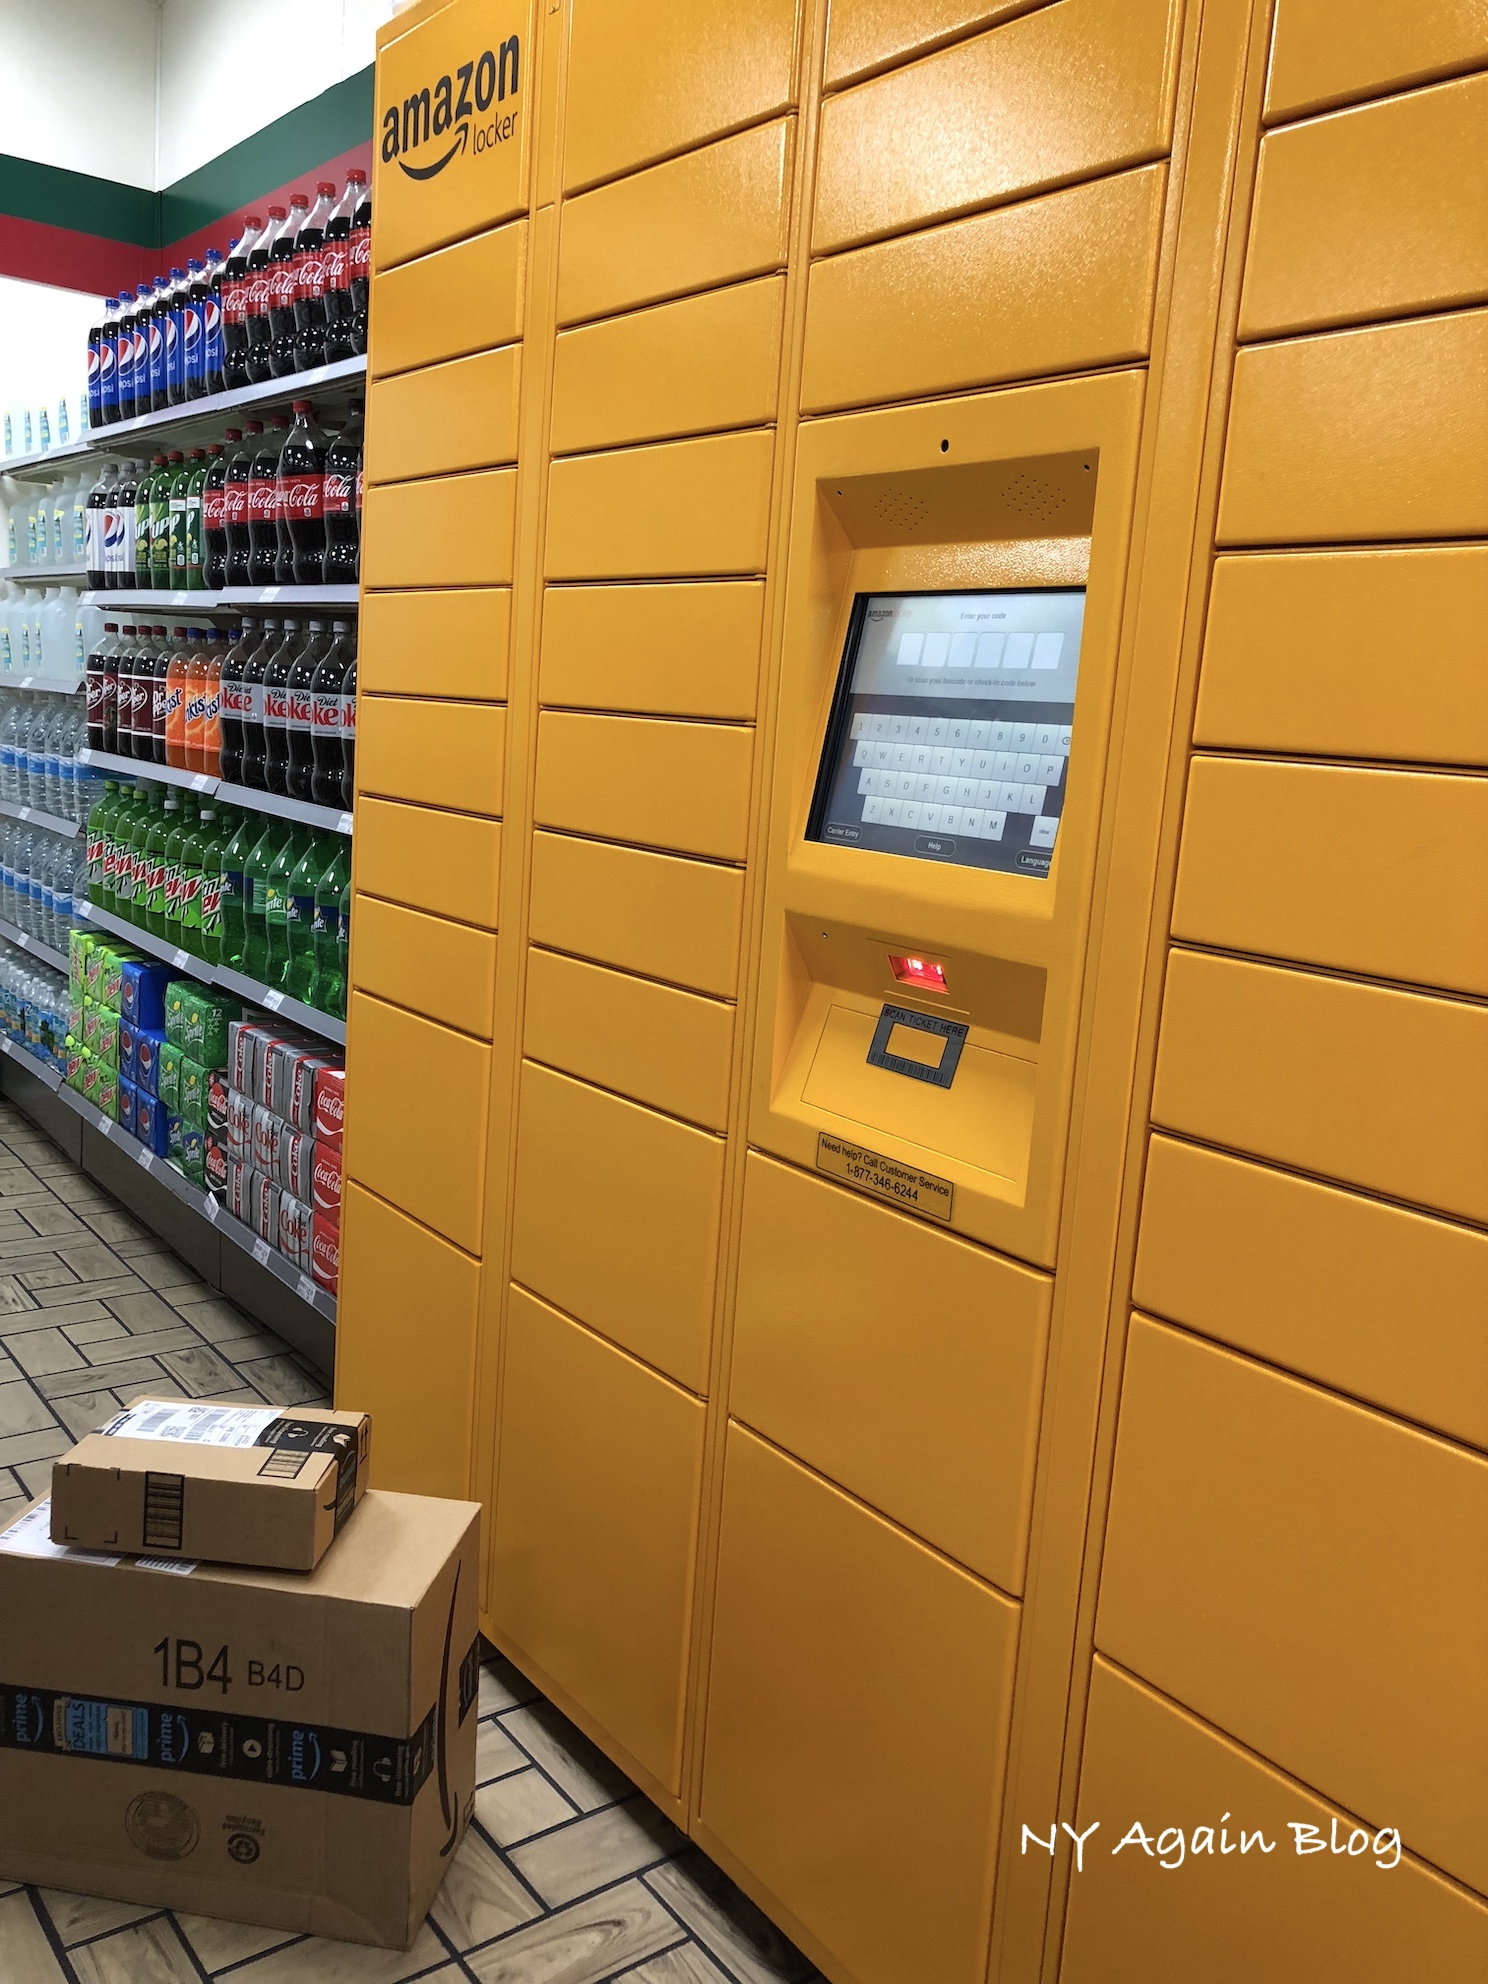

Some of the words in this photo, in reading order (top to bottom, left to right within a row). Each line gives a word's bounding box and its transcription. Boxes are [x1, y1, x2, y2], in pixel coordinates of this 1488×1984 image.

[381, 34, 520, 164] amazon
[473, 111, 518, 155] locker
[867, 610, 893, 618] amazon
[960, 612, 976, 620] Enter
[976, 613, 991, 621] your
[991, 612, 1007, 620] code
[929, 677, 942, 686] your
[942, 677, 967, 685] barcode
[974, 678, 1000, 686] check-in
[1000, 679, 1015, 687] code
[1017, 679, 1037, 688] below
[317, 695, 338, 707] Diet
[859, 723, 863, 731] 1
[876, 724, 882, 732] 2
[896, 725, 901, 733] 3
[915, 726, 920, 735] 4
[934, 728, 940, 736] 5
[955, 729, 961, 737] 6
[976, 730, 982, 739] 7
[997, 732, 1003, 740] 8
[1019, 733, 1025, 742] 9
[1042, 735, 1048, 744] 0
[861, 750, 868, 759] Q
[879, 751, 887, 760] W
[899, 753, 905, 762] E
[918, 755, 925, 763] R
[939, 756, 944, 765] T
[959, 758, 965, 767] Y
[980, 760, 986, 769] U
[1003, 762, 1006, 771] I
[1023, 764, 1031, 773] O
[1046, 766, 1054, 775] P
[865, 778, 871, 786] A
[884, 779, 890, 788] S
[903, 781, 910, 790] D
[923, 783, 929, 792] F
[942, 786, 950, 794] G
[964, 788, 970, 797] H
[985, 790, 991, 799] J
[1007, 793, 1014, 801] K
[1029, 795, 1035, 804] L
[869, 805, 876, 814] Z
[888, 808, 895, 816] X
[908, 810, 914, 819] C
[928, 812, 934, 821] V
[947, 815, 954, 824] B
[968, 818, 975, 827] N
[989, 821, 997, 829] M
[845, 829, 860, 839] Entry
[927, 841, 942, 852] Help
[1021, 855, 1051, 868] Languag
[212, 1008, 223, 1017] 12
[883, 1008, 905, 1021] SCAN
[909, 1014, 938, 1030] TICKET
[940, 1024, 965, 1038] HERE
[227, 1105, 250, 1135] Coke
[255, 1122, 279, 1154] Coke
[821, 1138, 841, 1154] Need
[841, 1145, 863, 1162] help?
[863, 1154, 878, 1168] Call
[879, 1161, 918, 1184] Customer
[918, 1176, 949, 1197] Service
[846, 1163, 919, 1202] 1-877-346-6244
[281, 1209, 307, 1244] Coke
[154, 1636, 233, 1695] 1B4
[248, 1660, 305, 1692] B4D
[12, 1693, 31, 1743] prime
[72, 1702, 86, 1750] DEALS
[157, 1712, 177, 1762] prime
[288, 1729, 307, 1781] prime
